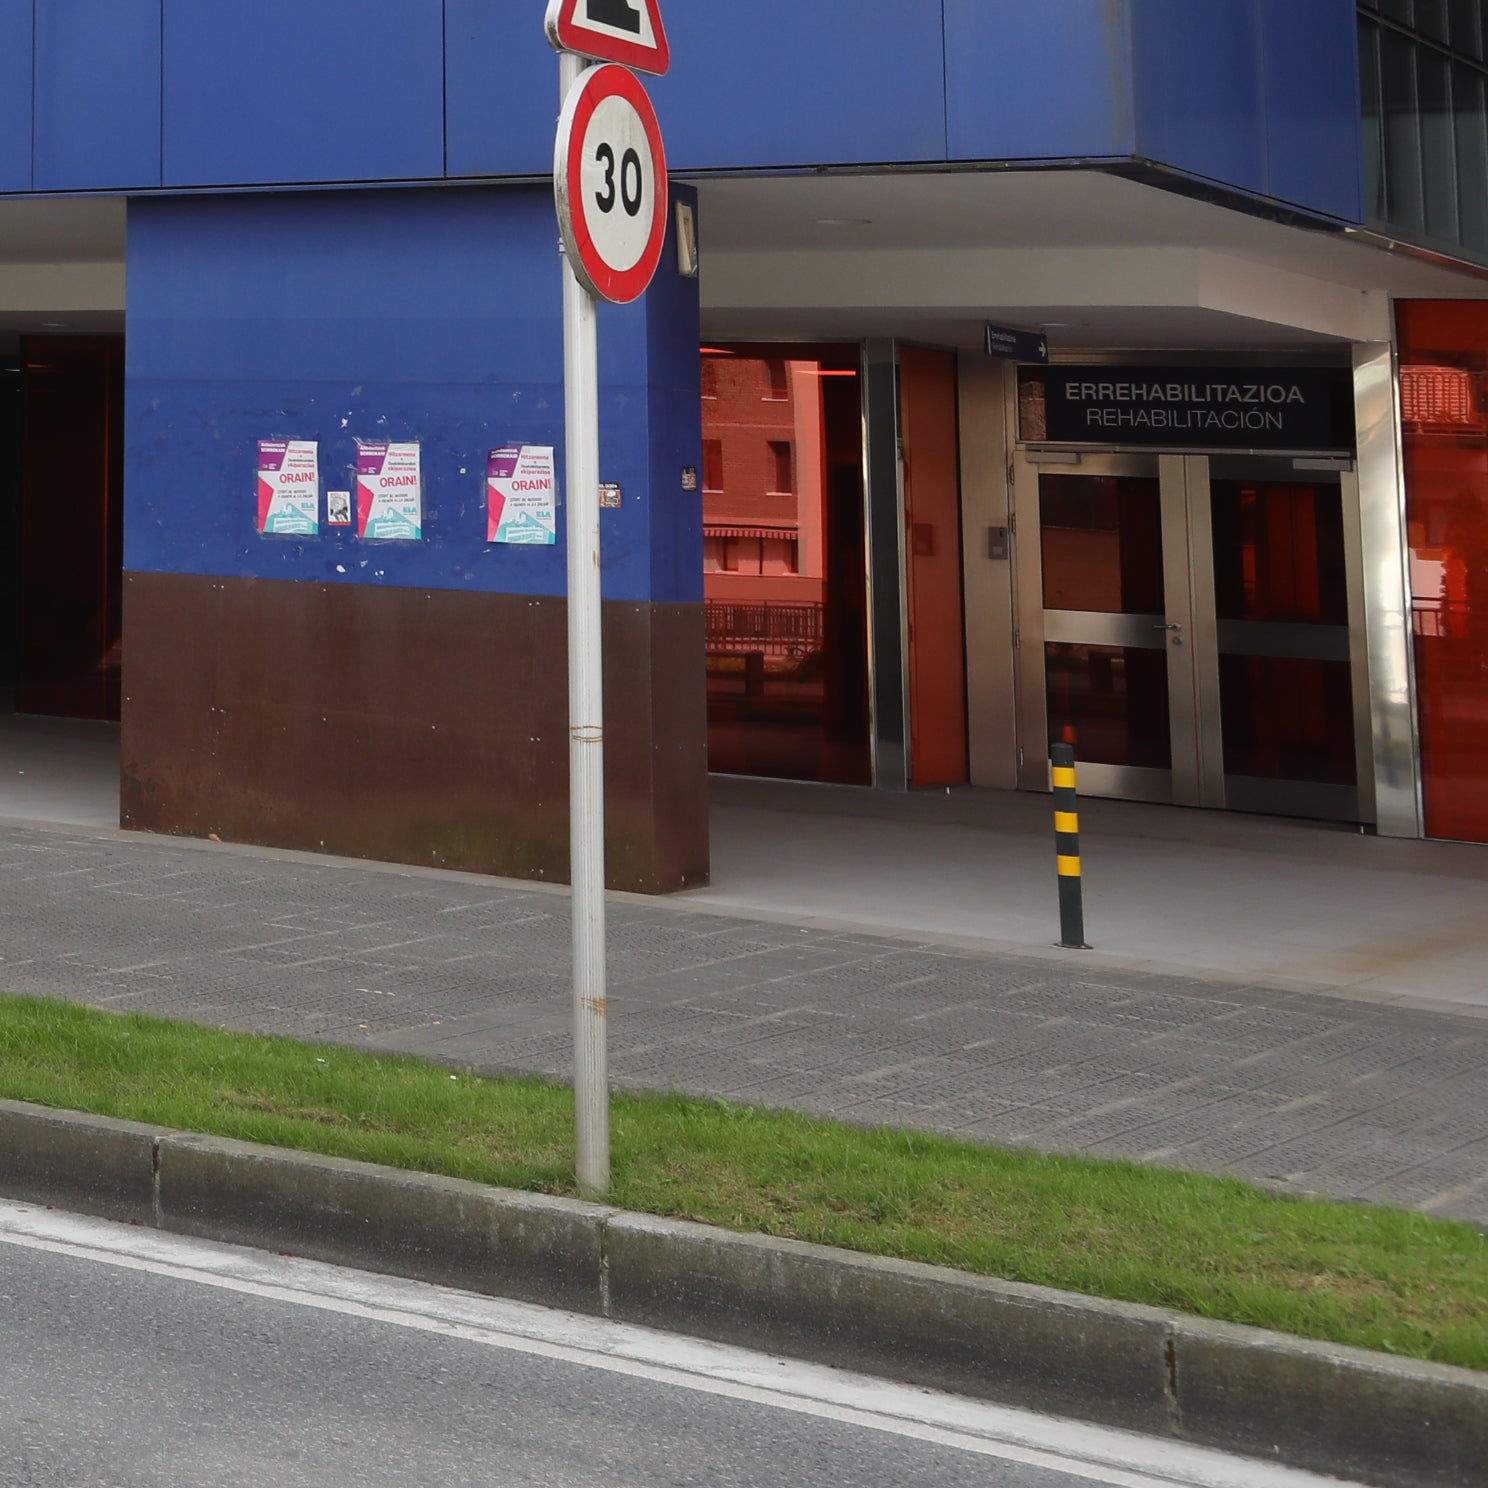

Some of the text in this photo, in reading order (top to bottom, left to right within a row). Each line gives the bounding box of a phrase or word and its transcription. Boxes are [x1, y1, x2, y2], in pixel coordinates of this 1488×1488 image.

[595, 142, 642, 217] 30
[1065, 382, 1305, 403] ERREHABILITAZIOA
[1086, 407, 1283, 430] REHABILITACIÓN
[279, 472, 315, 484] ORAIN!
[379, 475, 417, 488] ORAIN!
[511, 478, 552, 491] ORAIN!
